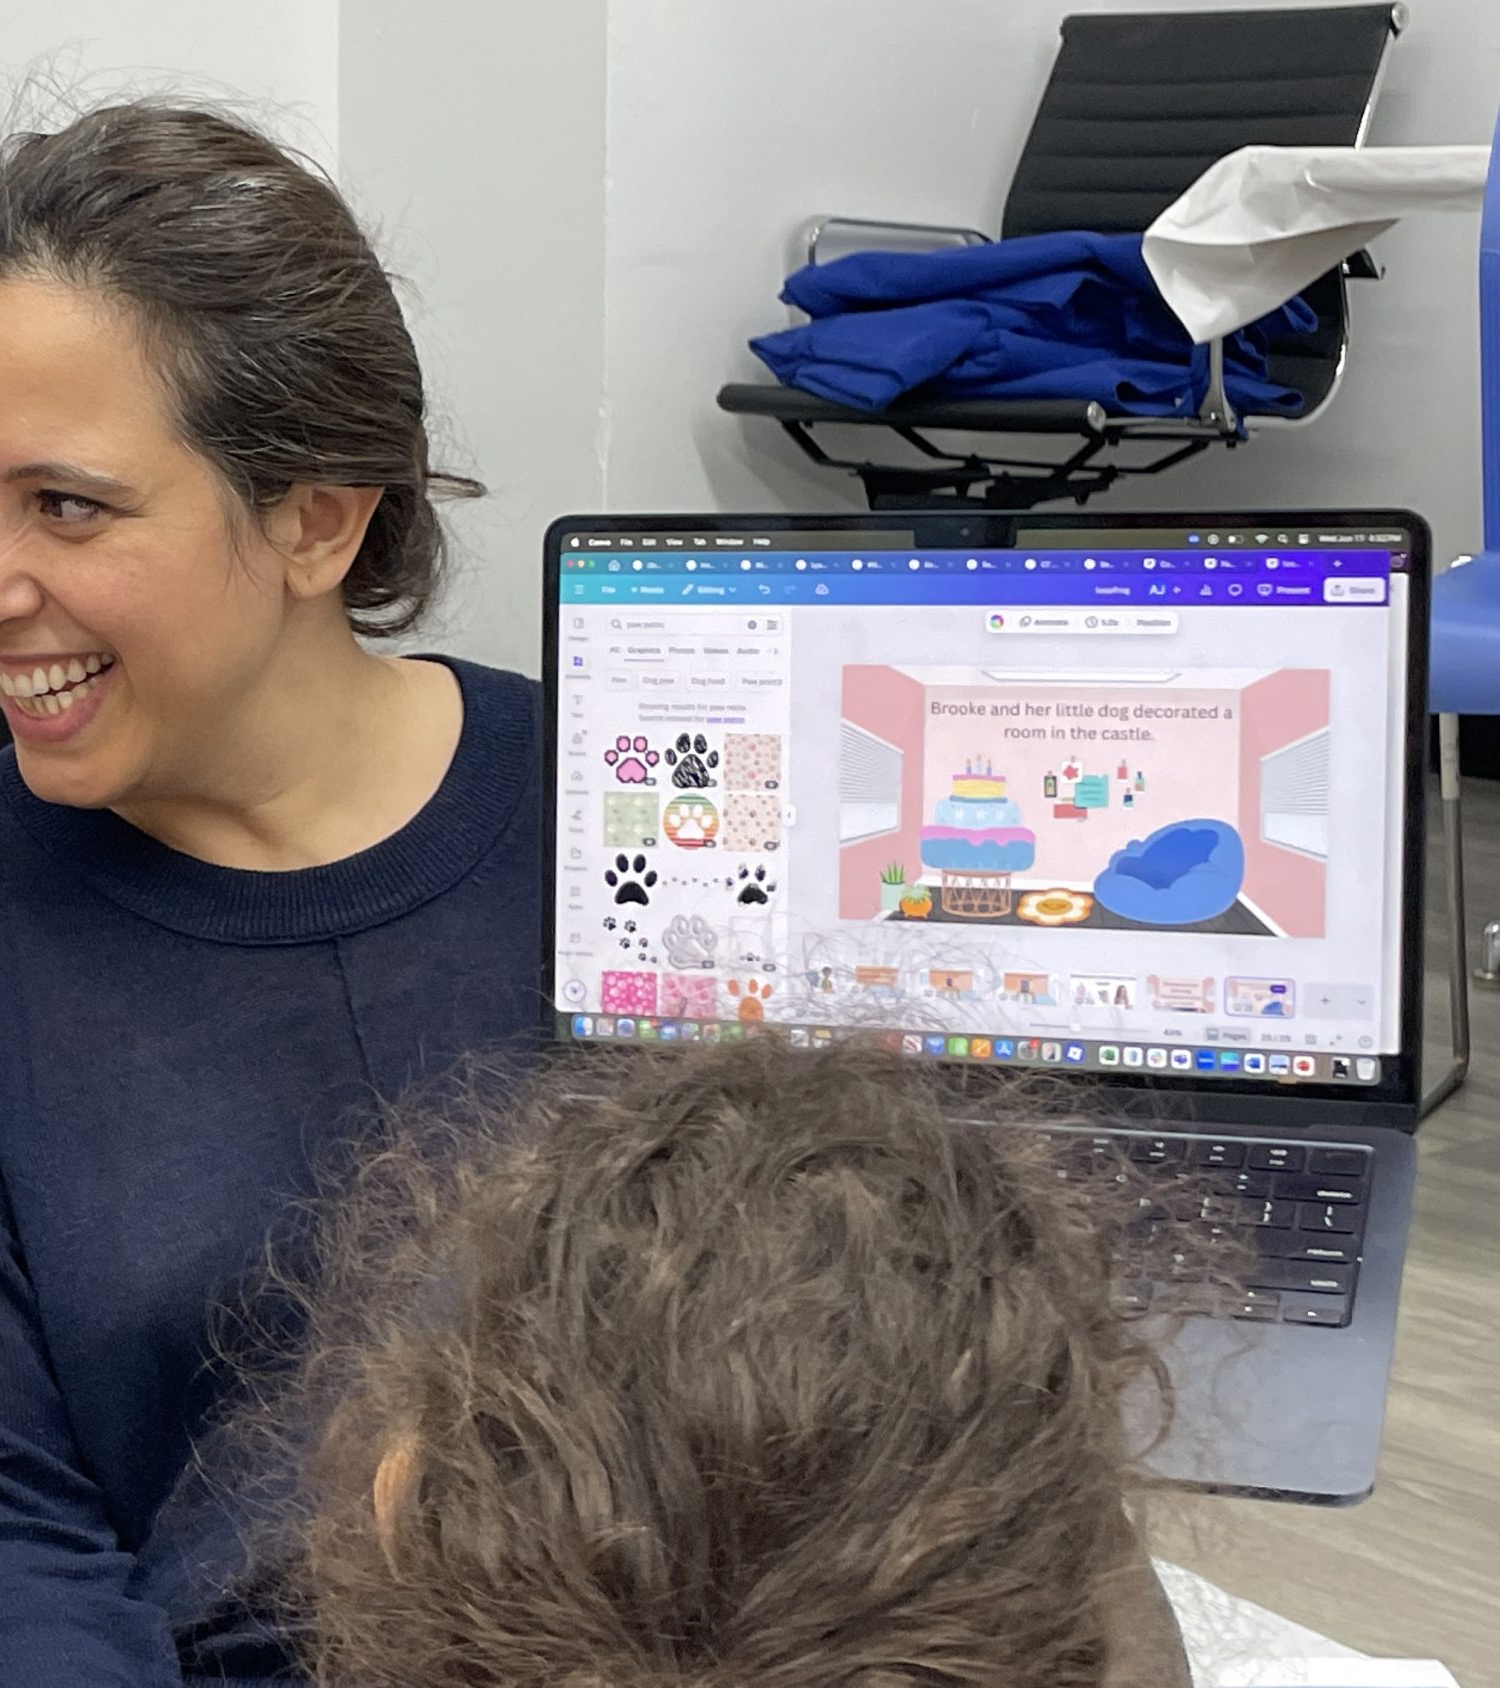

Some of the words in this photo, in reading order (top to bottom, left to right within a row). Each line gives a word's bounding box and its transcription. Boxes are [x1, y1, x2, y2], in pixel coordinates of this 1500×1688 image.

[930, 701, 986, 716] Brooke
[990, 702, 1020, 716] and
[1024, 702, 1052, 716] her
[1056, 703, 1094, 718] little
[1098, 704, 1129, 722] dog
[1132, 704, 1219, 720] decorated
[1223, 708, 1233, 720] a
[1004, 727, 1046, 739] room
[1051, 726, 1066, 740] in
[1070, 726, 1097, 740] the
[1100, 727, 1155, 741] castle.
